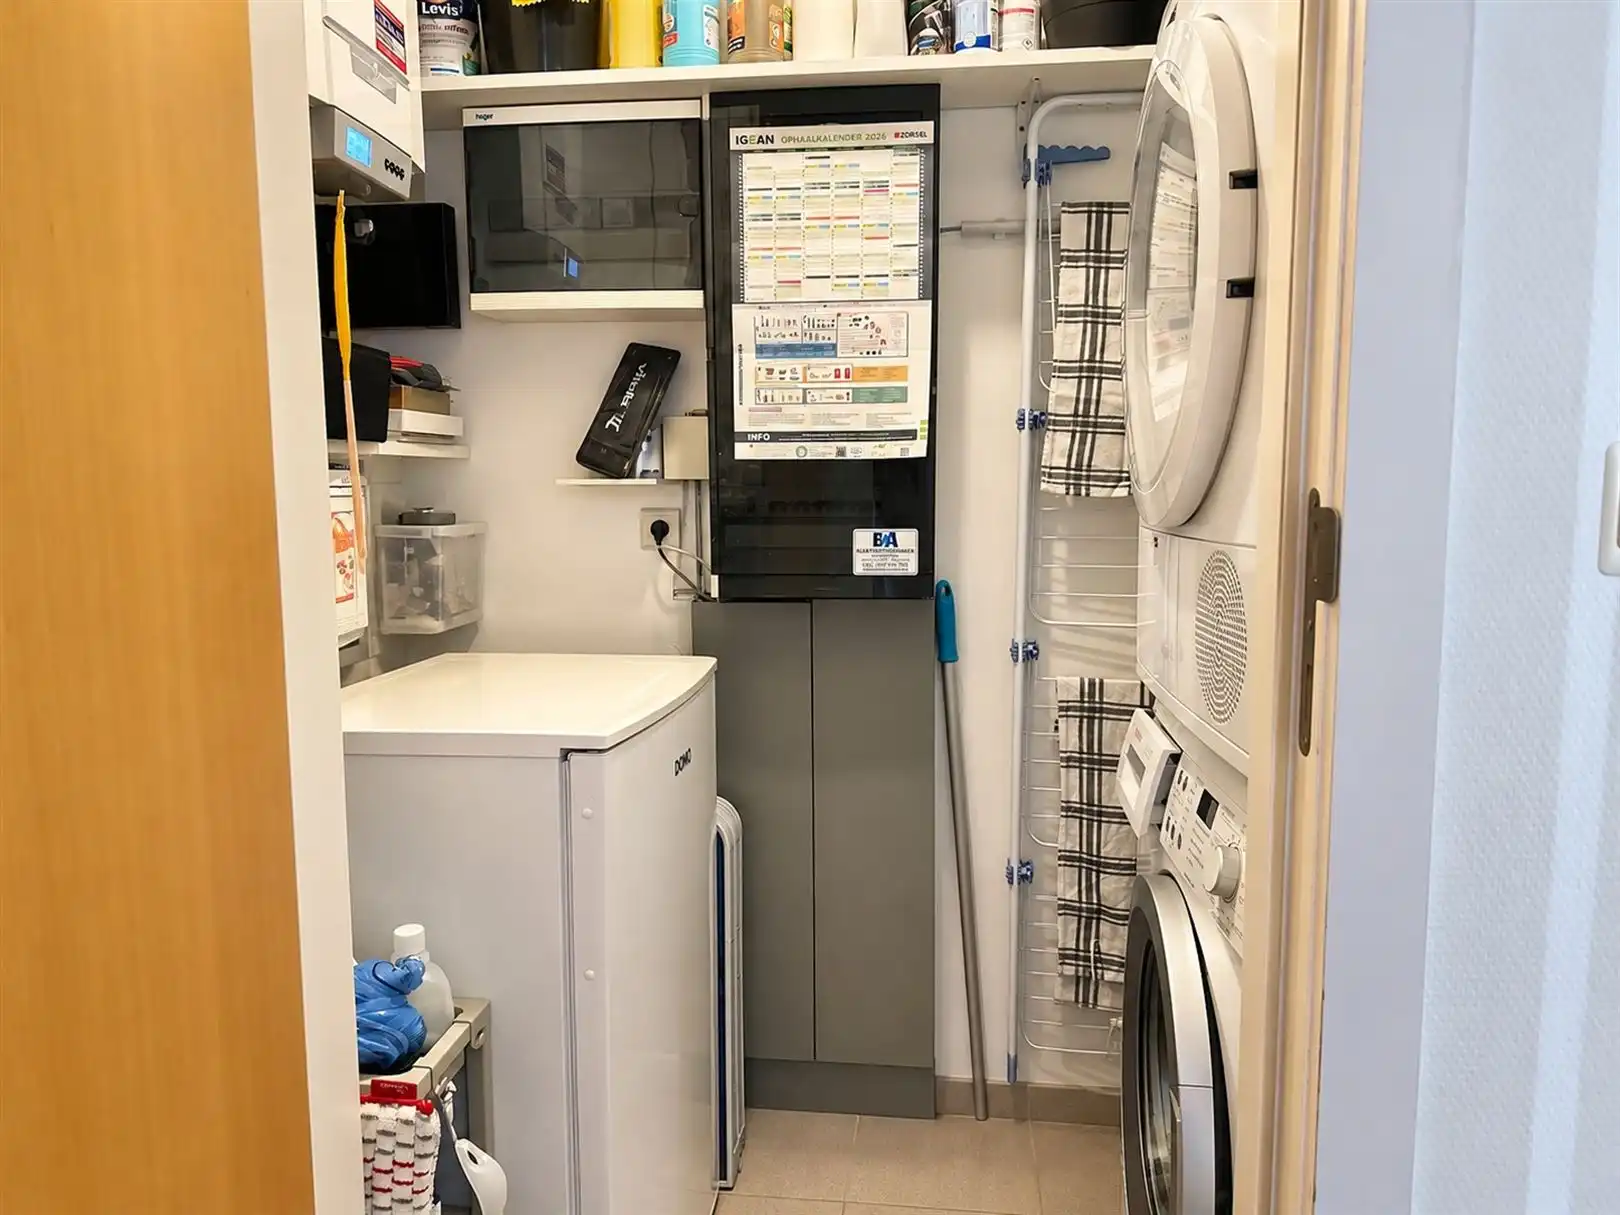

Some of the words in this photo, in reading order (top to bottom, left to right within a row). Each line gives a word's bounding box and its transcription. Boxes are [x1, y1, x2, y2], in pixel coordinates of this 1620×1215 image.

[421, 2, 459, 16] Levis
[475, 113, 494, 121] hager
[735, 134, 775, 145] IGEAN
[781, 133, 863, 144] OPHAALKALENDER
[865, 132, 887, 141] 2026
[747, 432, 771, 442] INFO
